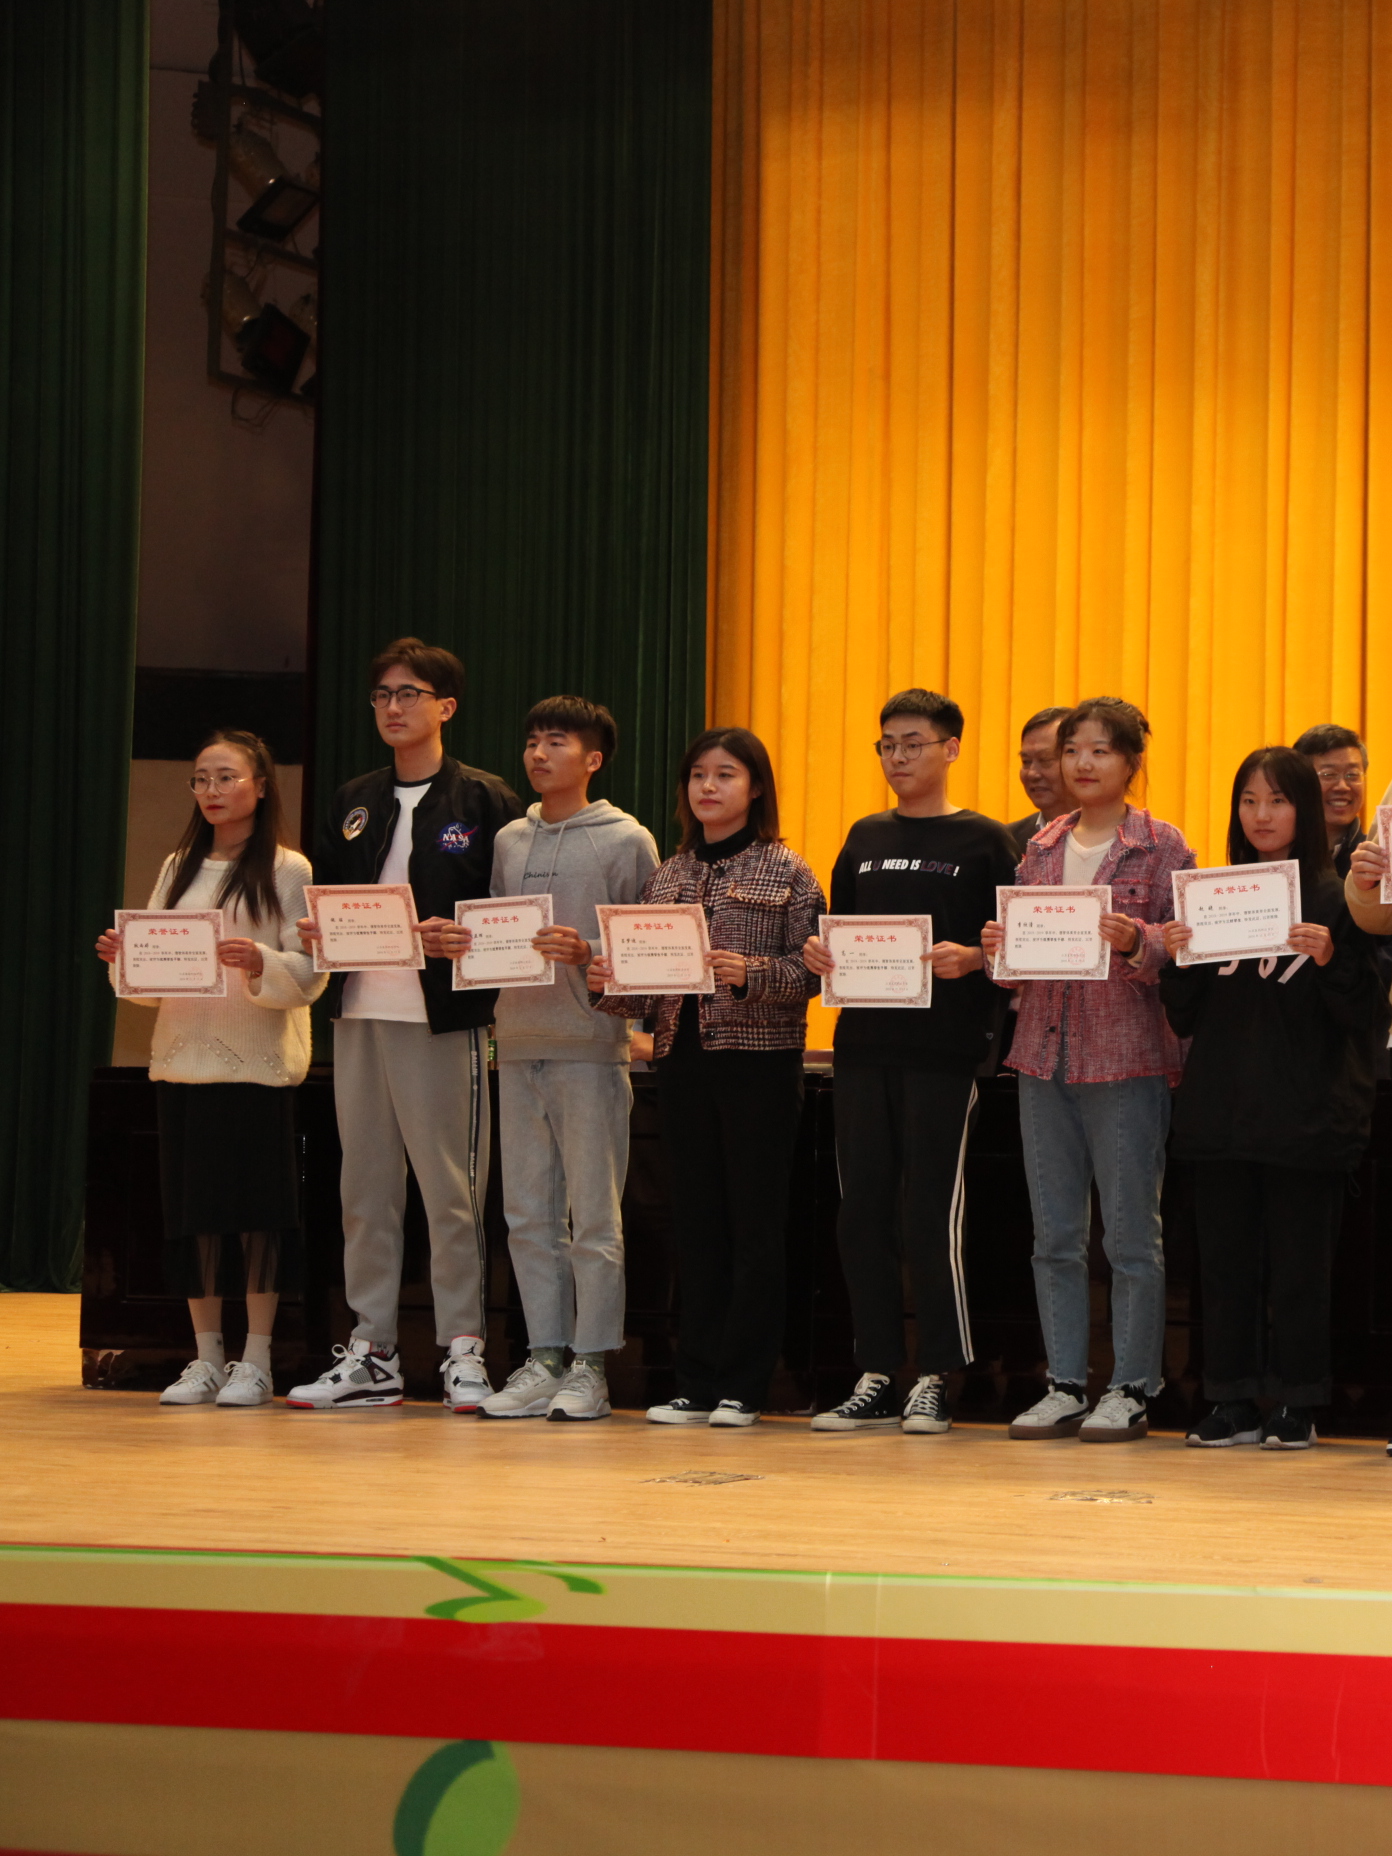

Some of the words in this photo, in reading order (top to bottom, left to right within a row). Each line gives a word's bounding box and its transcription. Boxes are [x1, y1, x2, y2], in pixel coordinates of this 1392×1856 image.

[442, 833, 470, 843] NASA
[859, 860, 873, 874] ALL
[882, 859, 909, 870] NEED
[910, 859, 922, 871] IS
[1213, 883, 1261, 895] 荣誉证书
[1033, 905, 1076, 914] 荣誉证书
[482, 916, 519, 924] 荣誉证书
[633, 922, 674, 930] 荣誉证书
